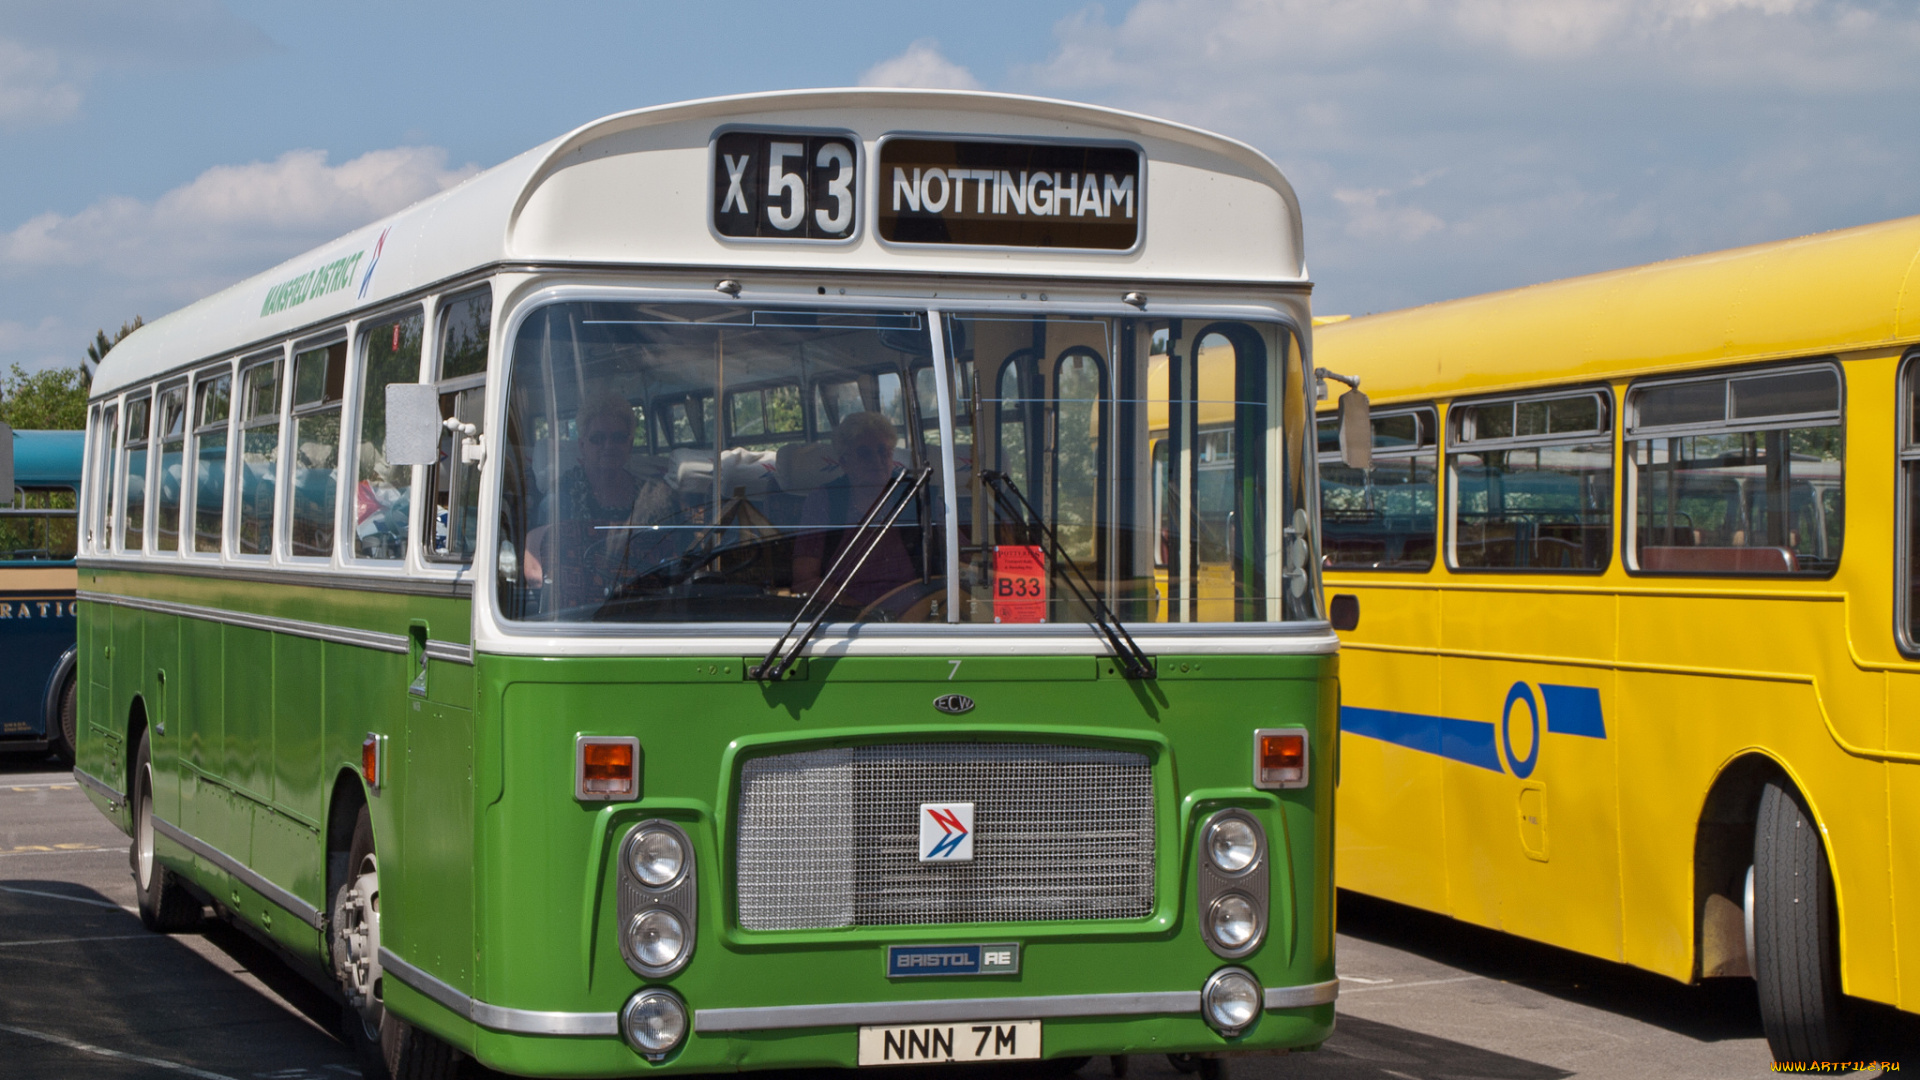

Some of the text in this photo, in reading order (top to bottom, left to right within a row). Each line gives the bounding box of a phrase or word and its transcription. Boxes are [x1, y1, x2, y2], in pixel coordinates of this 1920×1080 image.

[720, 142, 854, 233] X 53
[892, 166, 1134, 219] NOTTINGHAM
[260, 250, 364, 318] MANSFIELD DISTRICT
[998, 578, 1041, 597] B33
[948, 660, 962, 680] 7
[938, 696, 971, 711] ECW
[896, 951, 1011, 968] BRISTOL RE
[883, 1025, 1016, 1060] NNN 7M
